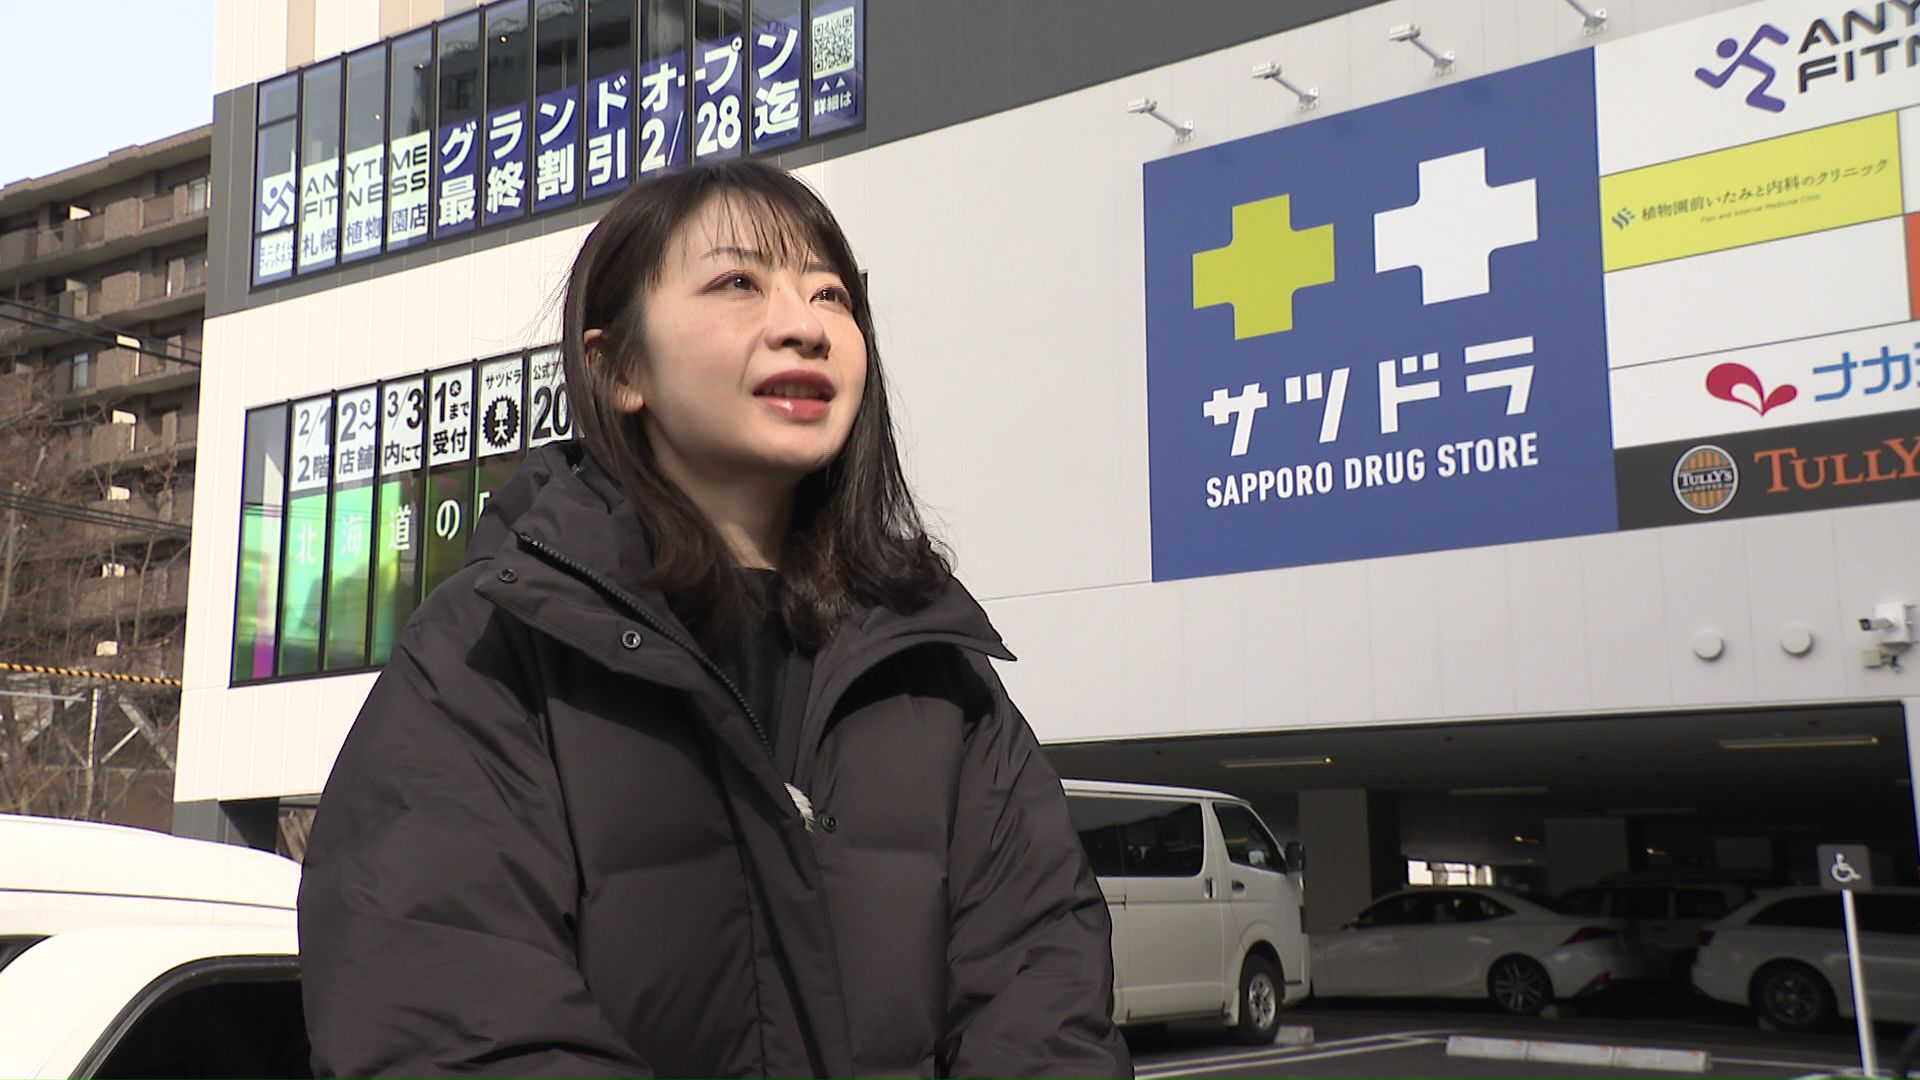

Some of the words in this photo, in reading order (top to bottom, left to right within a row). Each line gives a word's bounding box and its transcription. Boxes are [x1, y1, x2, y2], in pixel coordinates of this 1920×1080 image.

[441, 28, 798, 174] グランドオープン
[303, 170, 426, 222] FITNESS
[305, 144, 427, 198] ANYTIME
[1203, 336, 1534, 456] サツドラ
[1812, 342, 1920, 402] ナカ
[1206, 461, 1333, 508] SAPPORO
[1344, 447, 1425, 490] DRUG
[1437, 432, 1538, 477] STORE
